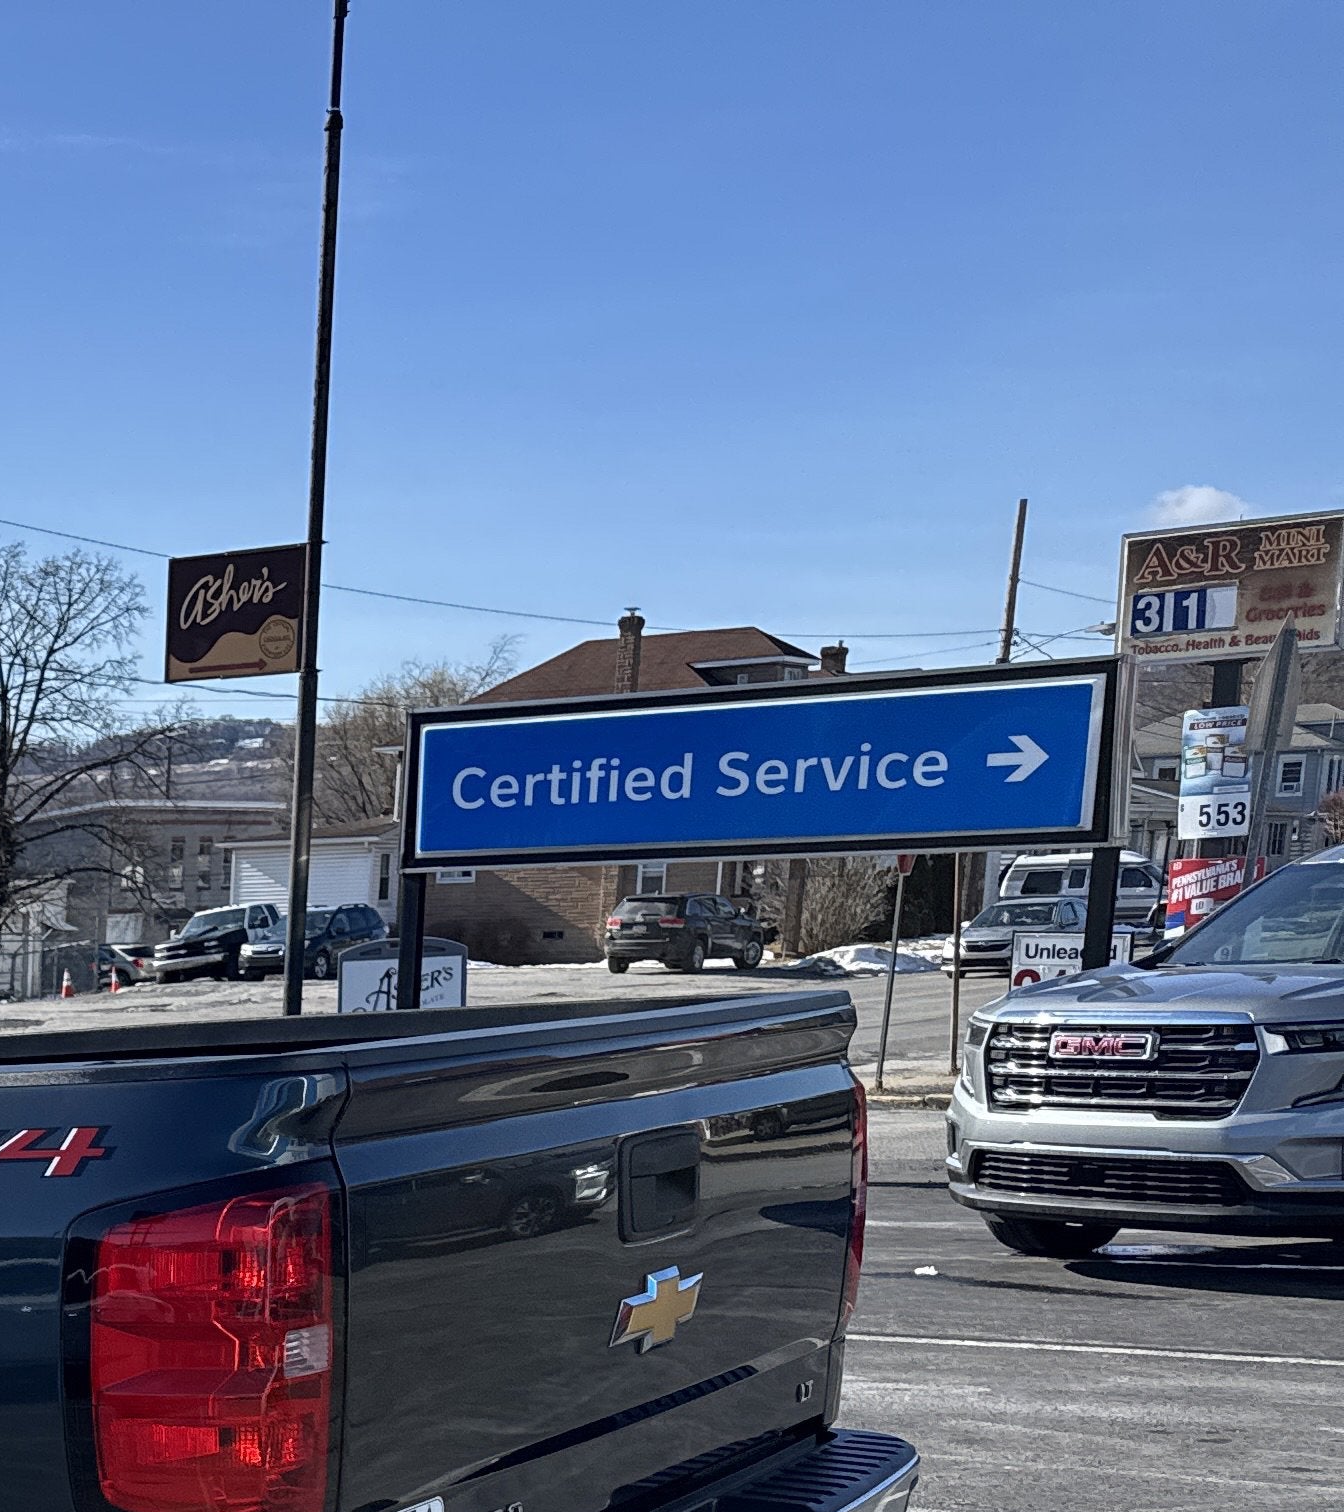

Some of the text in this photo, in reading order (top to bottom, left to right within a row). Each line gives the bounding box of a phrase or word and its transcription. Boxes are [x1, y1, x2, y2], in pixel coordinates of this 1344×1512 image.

[1261, 525, 1325, 549] MINI
[1133, 536, 1246, 584] A&R
[1253, 545, 1330, 571] MART
[179, 563, 288, 630] Asher's
[1185, 638, 1224, 651] Health
[1228, 635, 1242, 647] &
[451, 742, 950, 812] Certified Service
[1199, 802, 1246, 828] 553
[1172, 860, 1238, 890] PENNSYLVANIA'S
[1171, 888, 1183, 904] #1
[1184, 877, 1217, 899] VALUE
[1055, 1035, 1146, 1056] GMC
